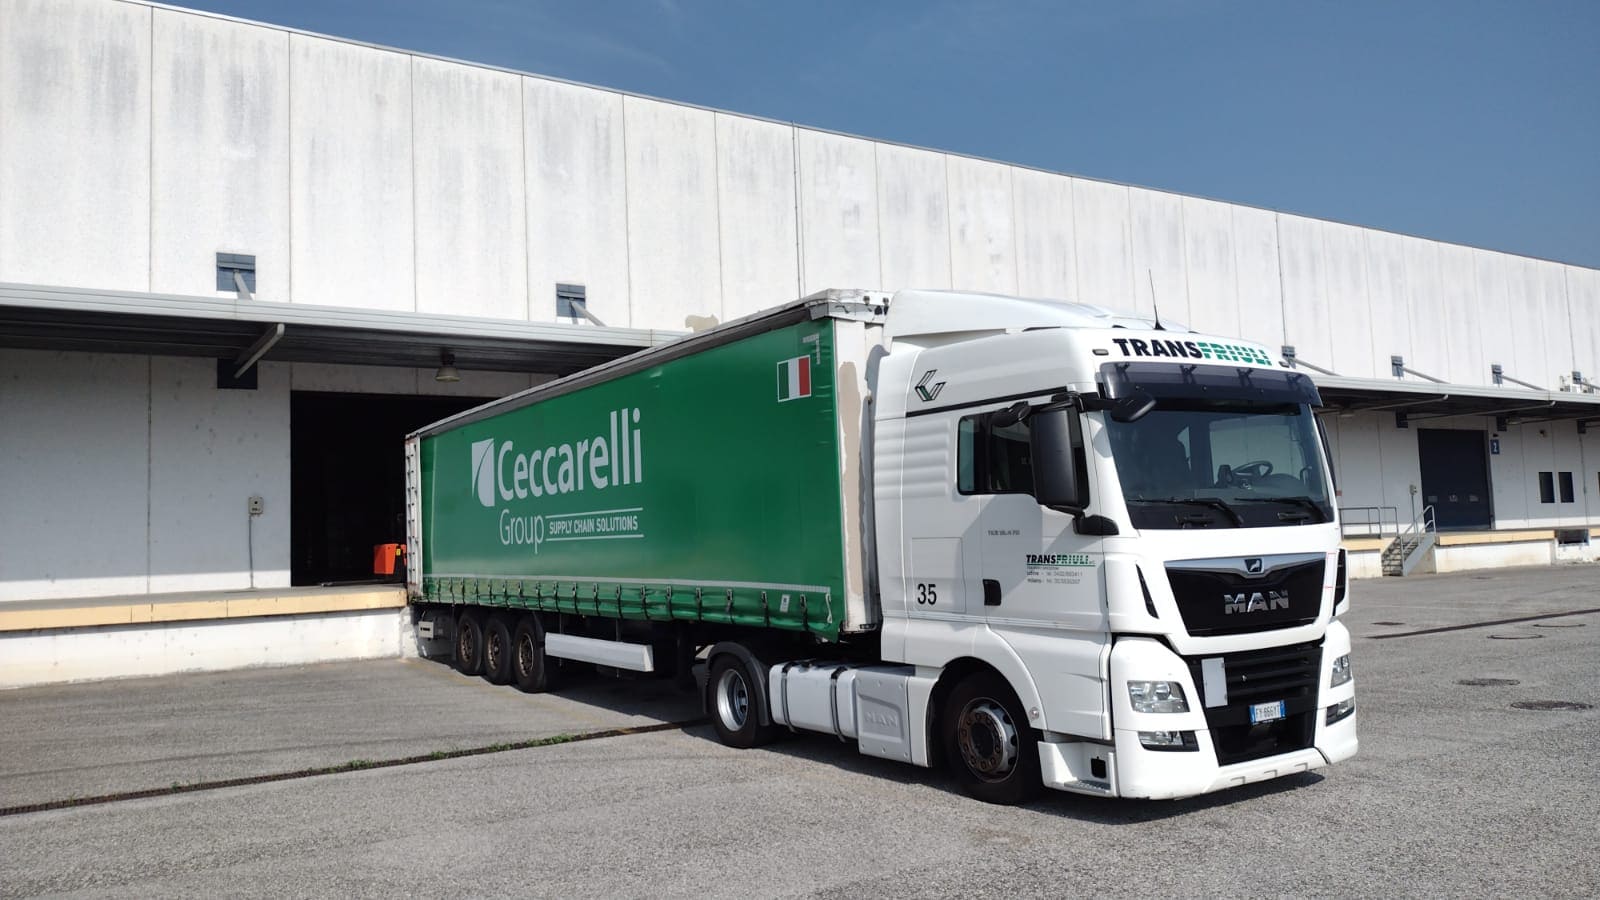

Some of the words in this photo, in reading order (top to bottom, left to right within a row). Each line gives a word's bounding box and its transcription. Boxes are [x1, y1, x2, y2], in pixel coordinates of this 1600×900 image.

[1112, 338, 1272, 366] TRANSFRIULI
[497, 407, 642, 501] Ceccarelli
[499, 508, 544, 554] Group
[549, 519, 573, 535] SUPPLY
[573, 518, 595, 534] CHAIN
[595, 515, 638, 533] SOLUTIONS
[1026, 554, 1089, 565] TRANSFRIULI
[917, 583, 937, 605] 35
[1223, 590, 1289, 615] MAN
[864, 711, 899, 728] MAN
